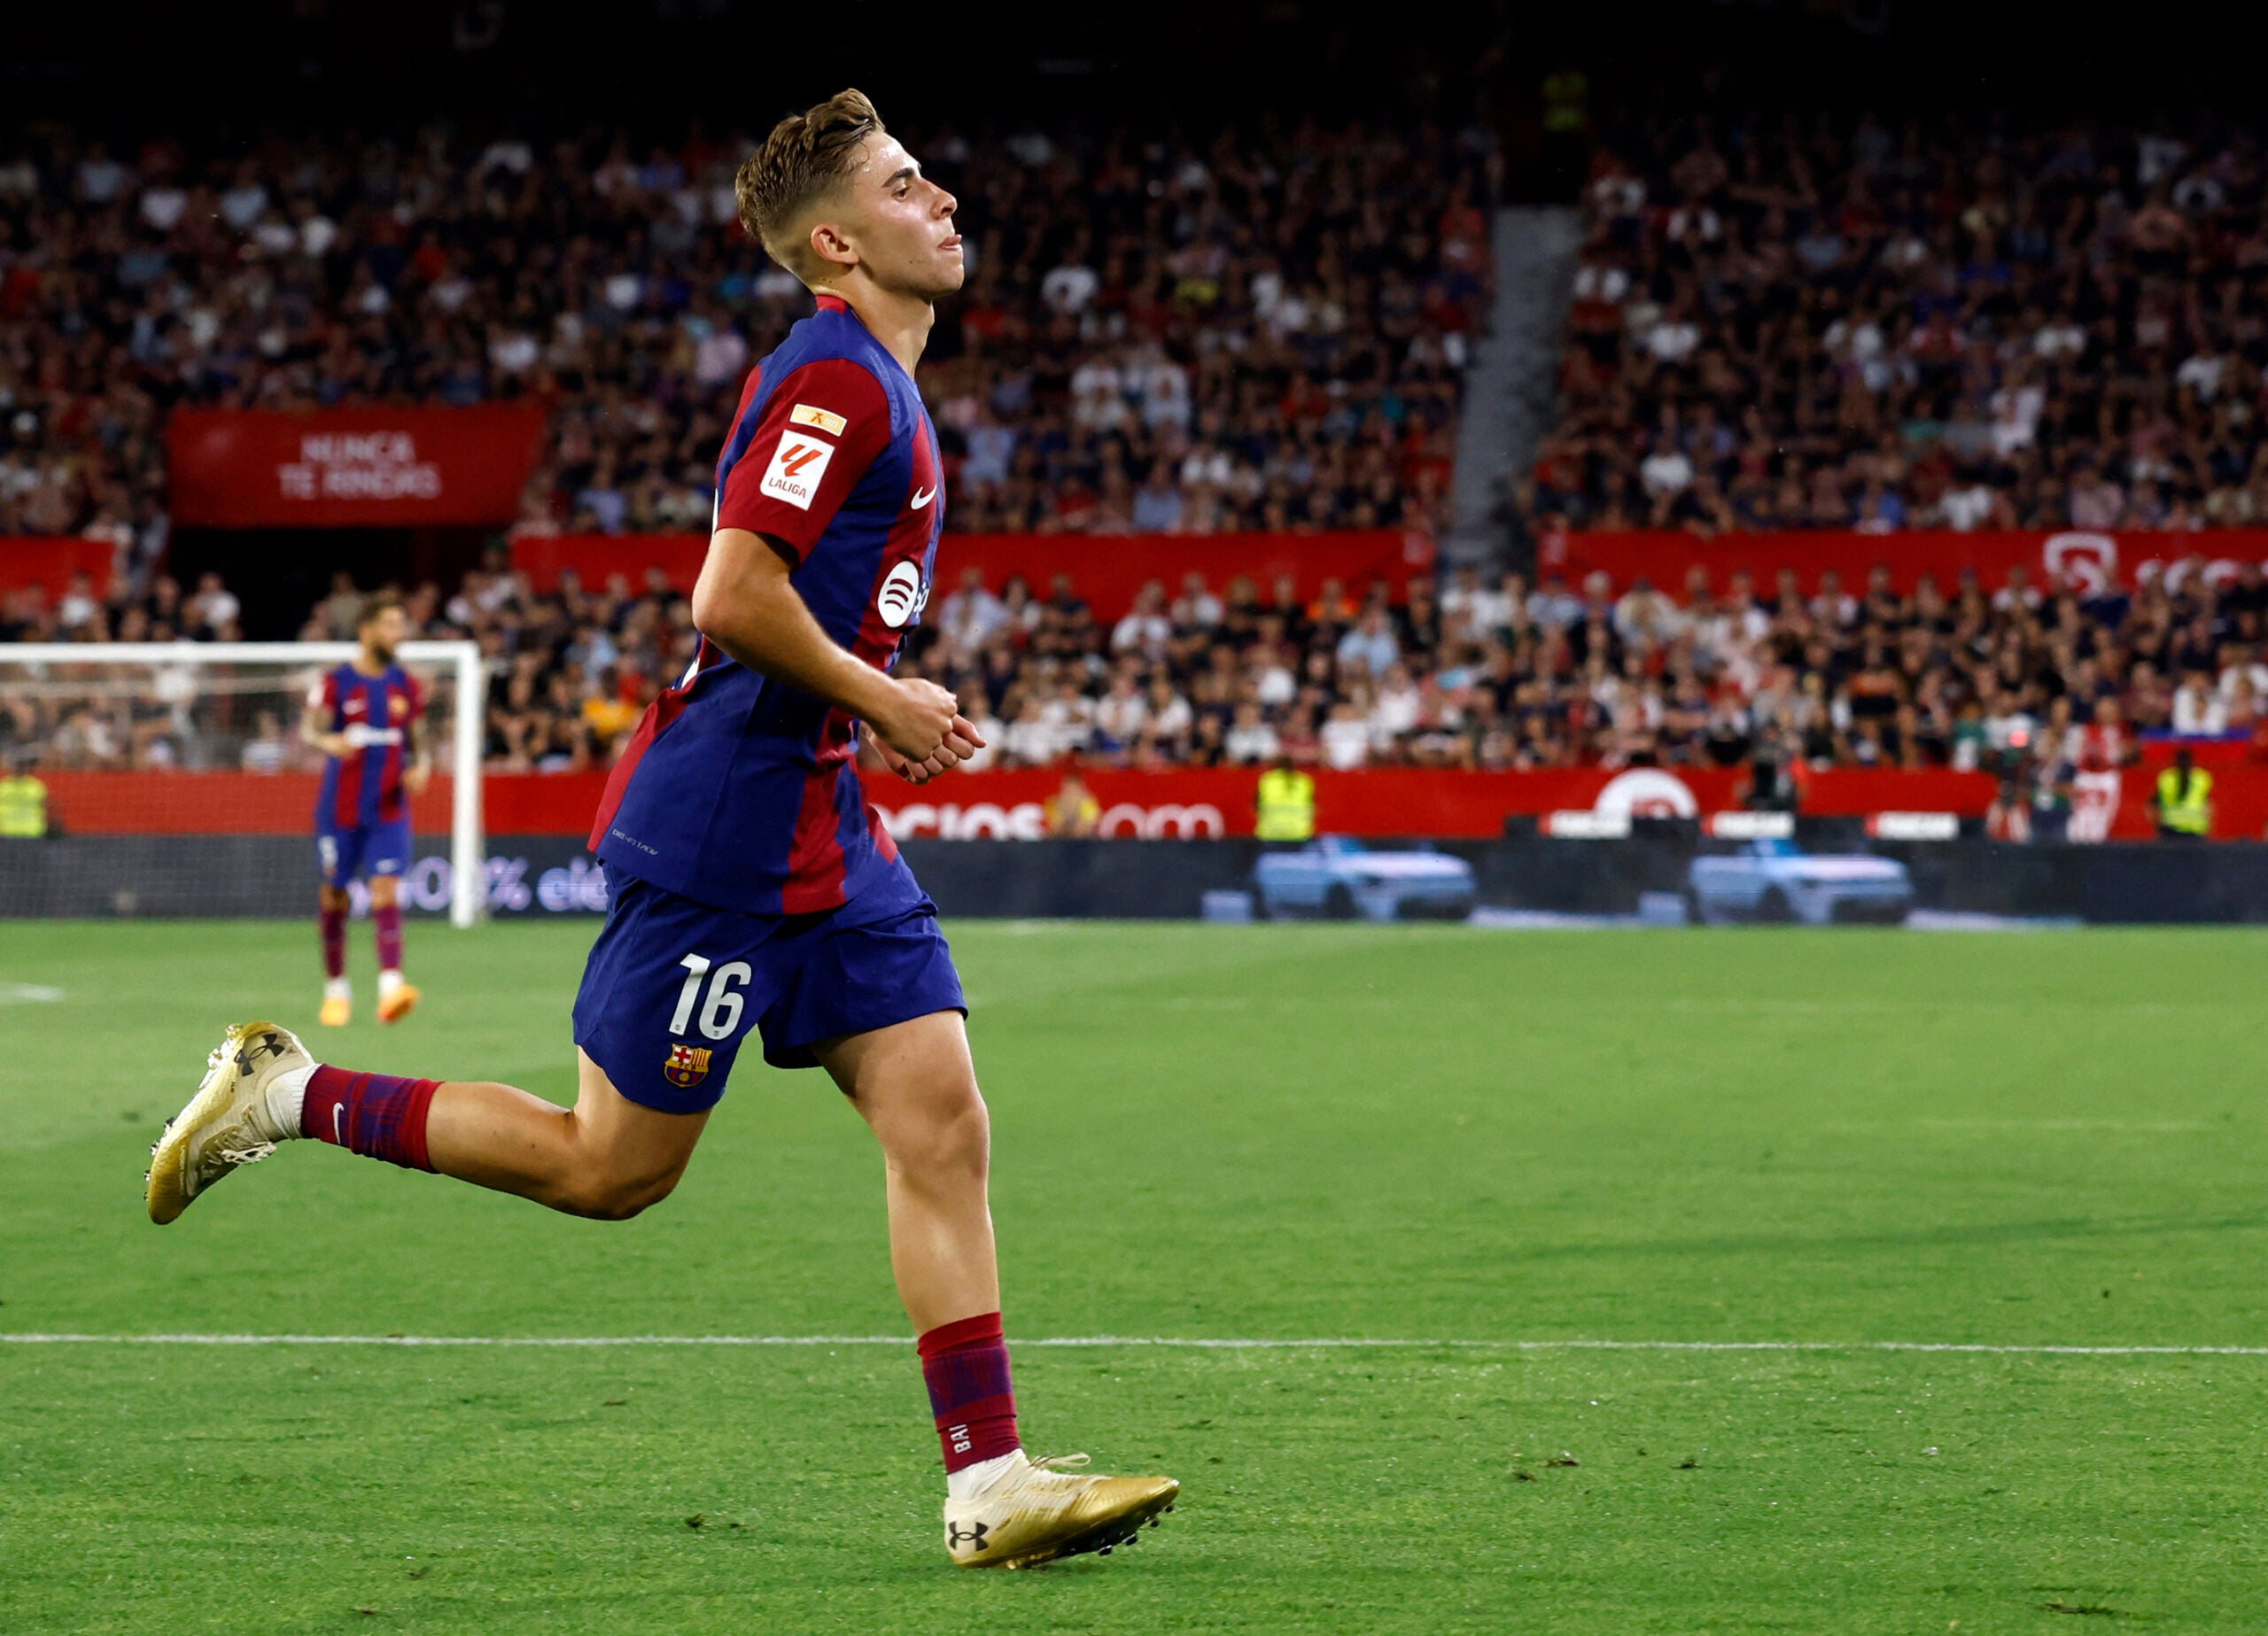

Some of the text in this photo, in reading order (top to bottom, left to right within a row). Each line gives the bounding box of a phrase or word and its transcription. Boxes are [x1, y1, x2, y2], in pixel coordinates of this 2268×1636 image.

[301, 431, 415, 462] NUNCA
[768, 477, 807, 499] LALIGA
[669, 953, 752, 1041] 16
